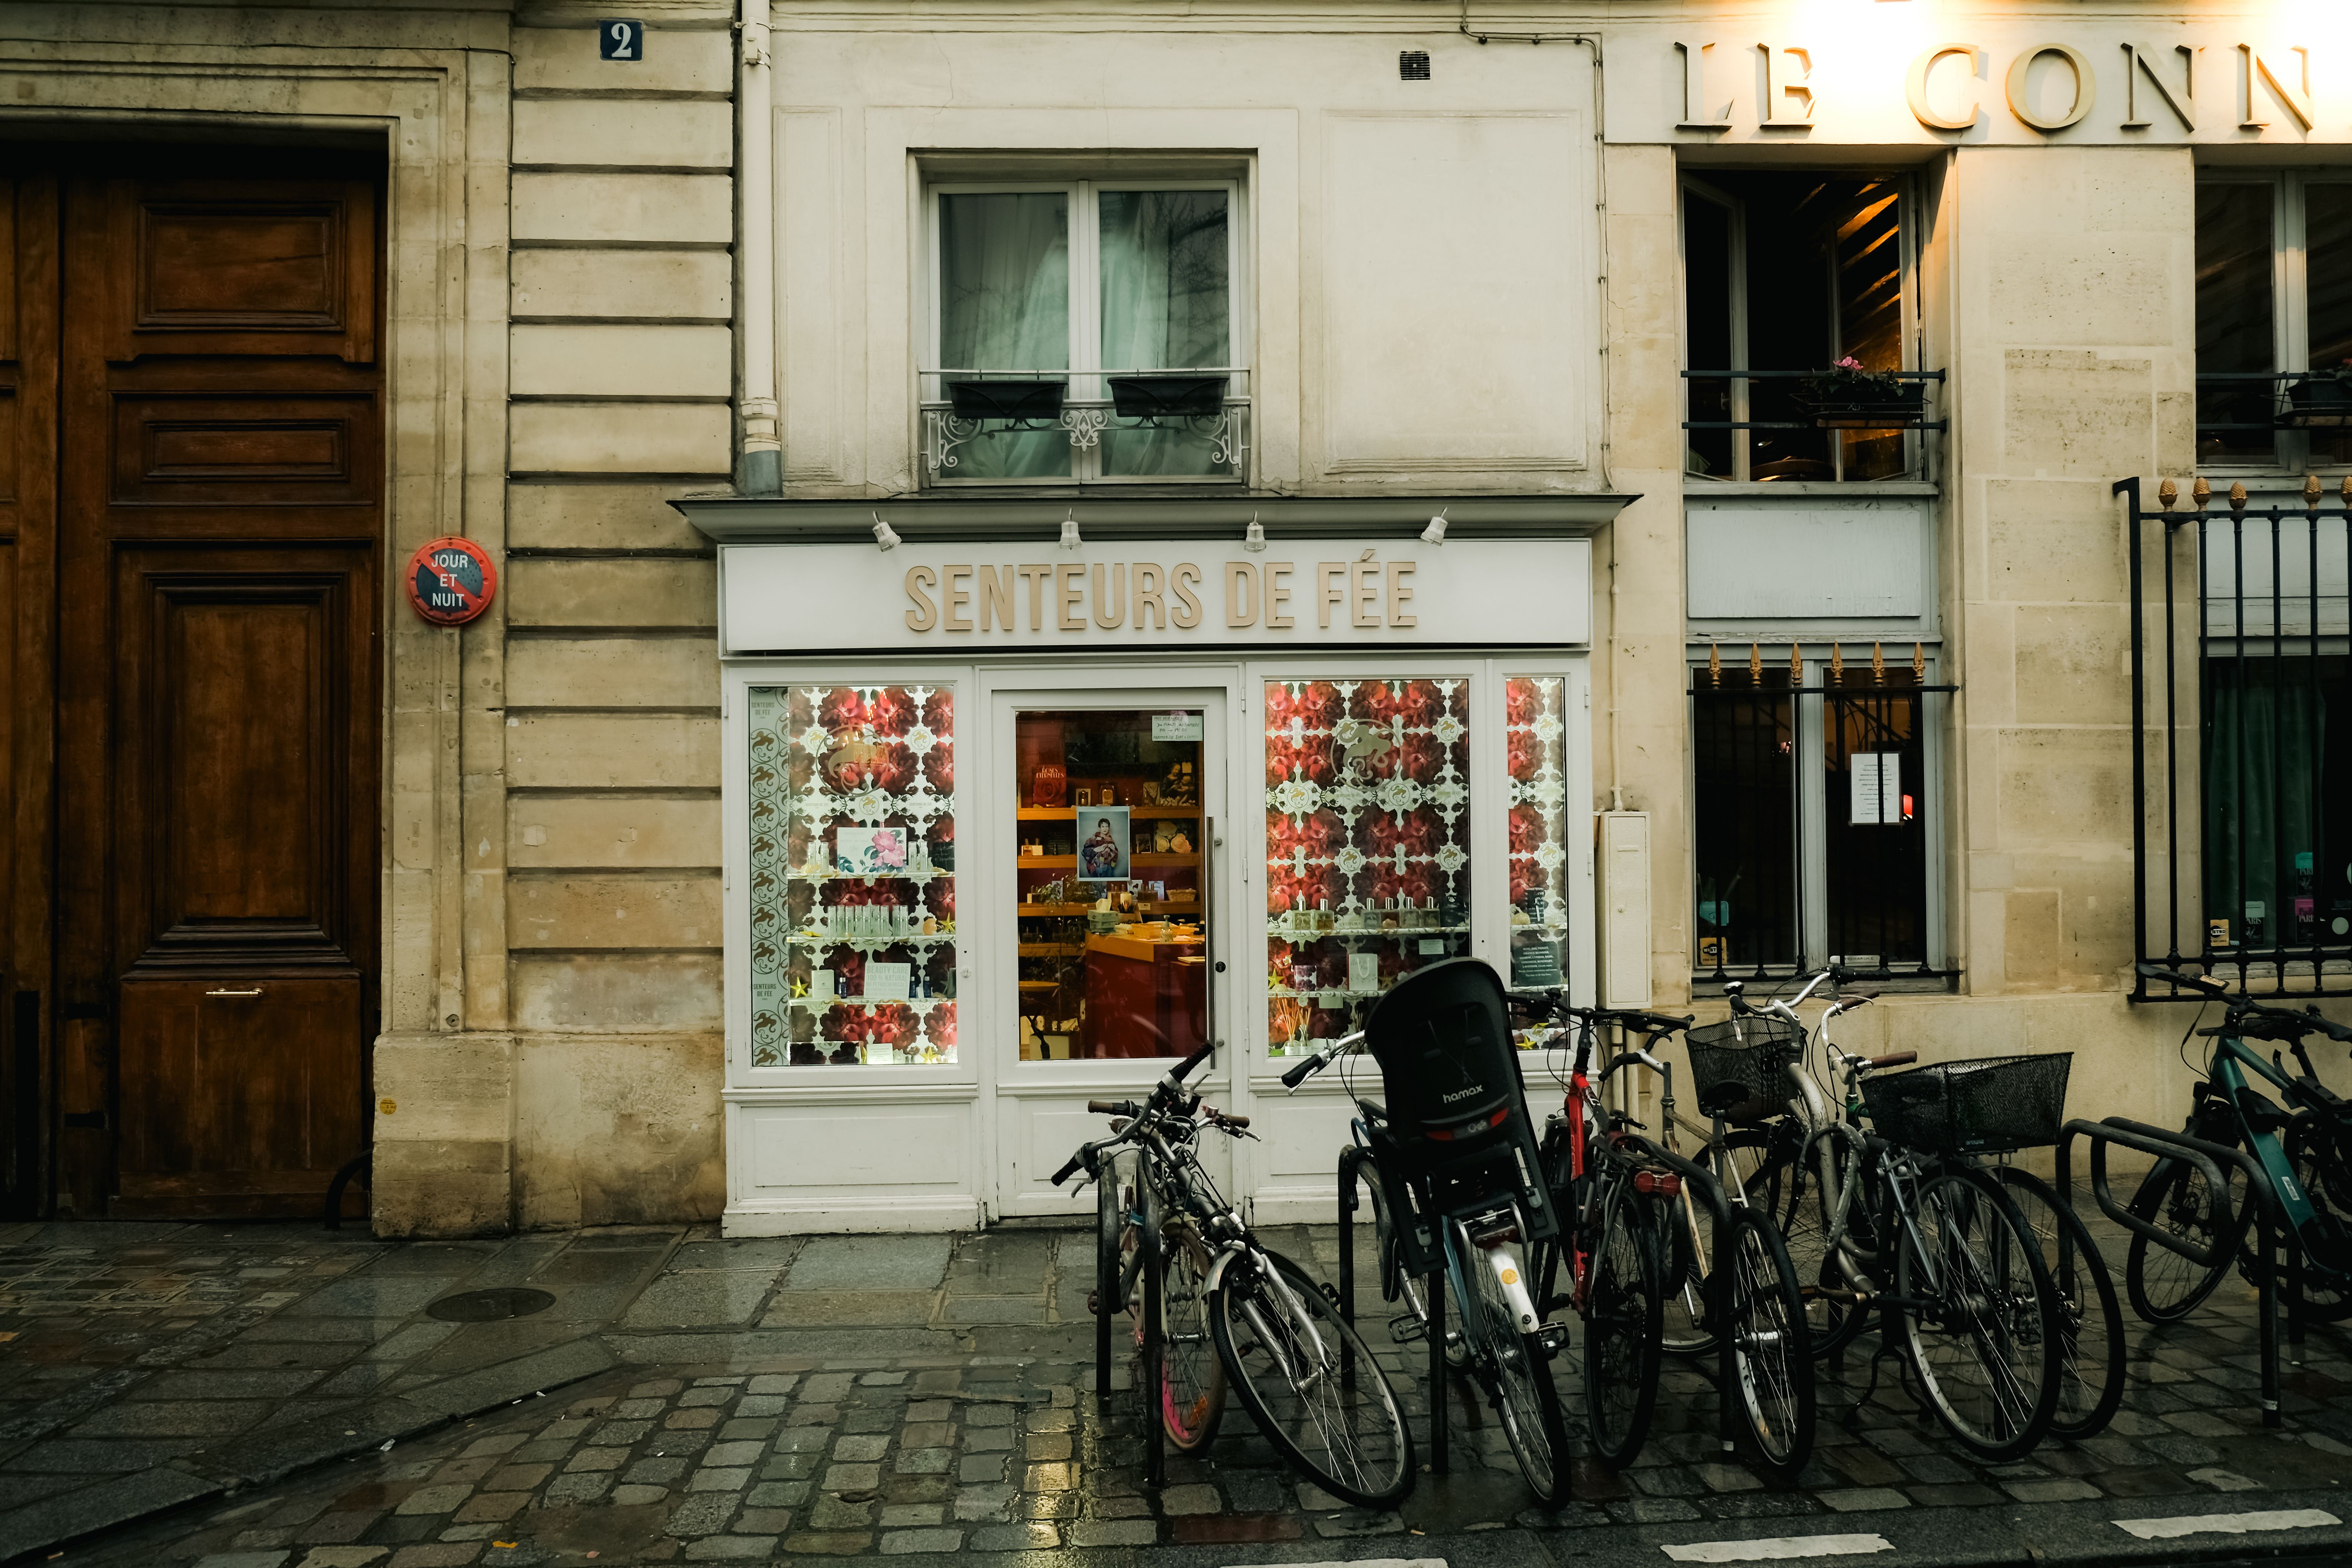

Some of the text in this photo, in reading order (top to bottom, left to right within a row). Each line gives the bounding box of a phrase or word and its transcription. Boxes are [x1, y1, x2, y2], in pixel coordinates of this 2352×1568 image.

[611, 23, 631, 57] 2
[1674, 41, 1816, 130] LE
[431, 554, 468, 568] JOUR
[440, 574, 457, 587] ET
[432, 593, 464, 606] NUIT
[905, 549, 1417, 632] SENTEURS DE FÉE
[1443, 1085, 1483, 1103] hamax
